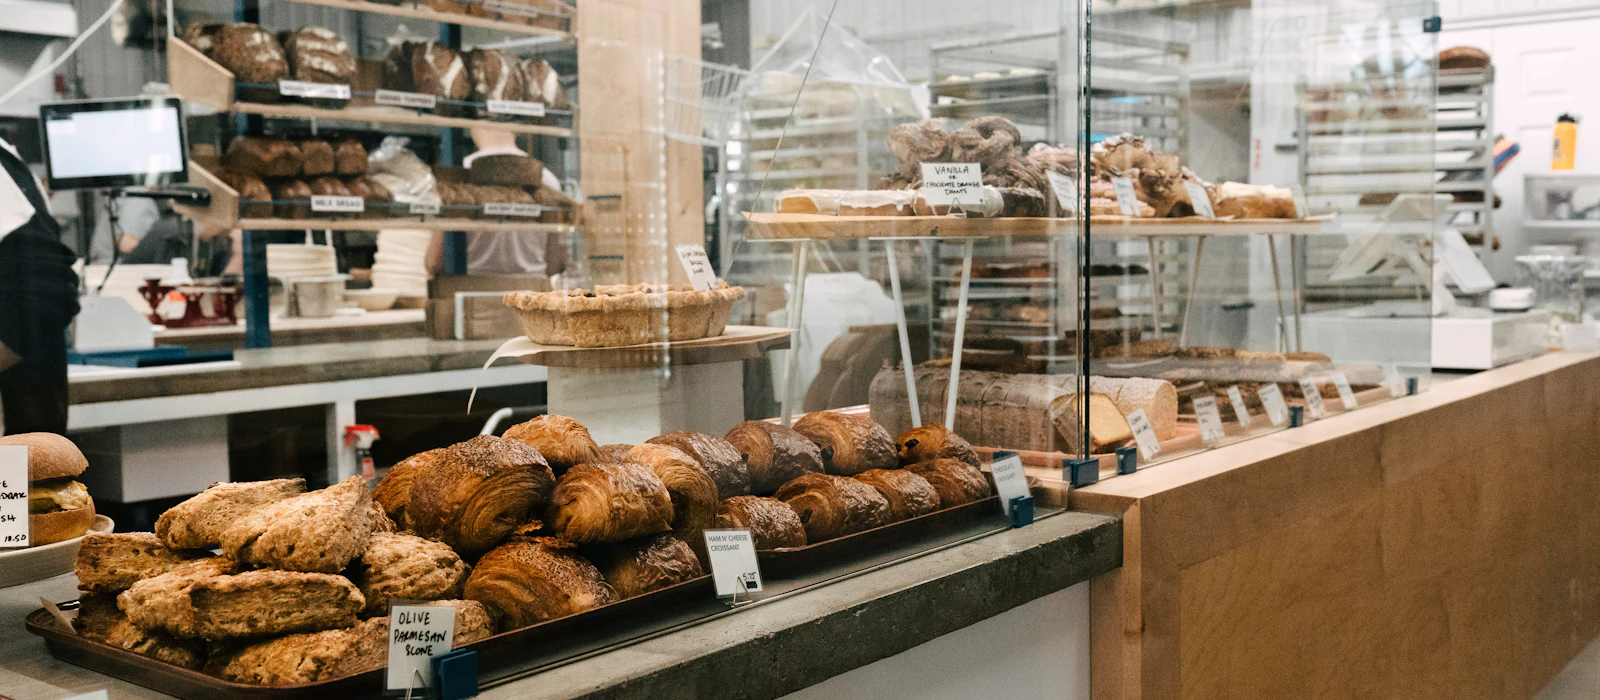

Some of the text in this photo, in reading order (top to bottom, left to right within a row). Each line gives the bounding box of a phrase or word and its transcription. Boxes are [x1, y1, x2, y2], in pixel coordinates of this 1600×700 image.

[934, 165, 969, 175] VANILLA
[994, 463, 1015, 473] CHOCOLATE
[398, 611, 430, 626] OLIVE
[393, 628, 447, 644] PARMESAN
[405, 644, 434, 657] SCONE
